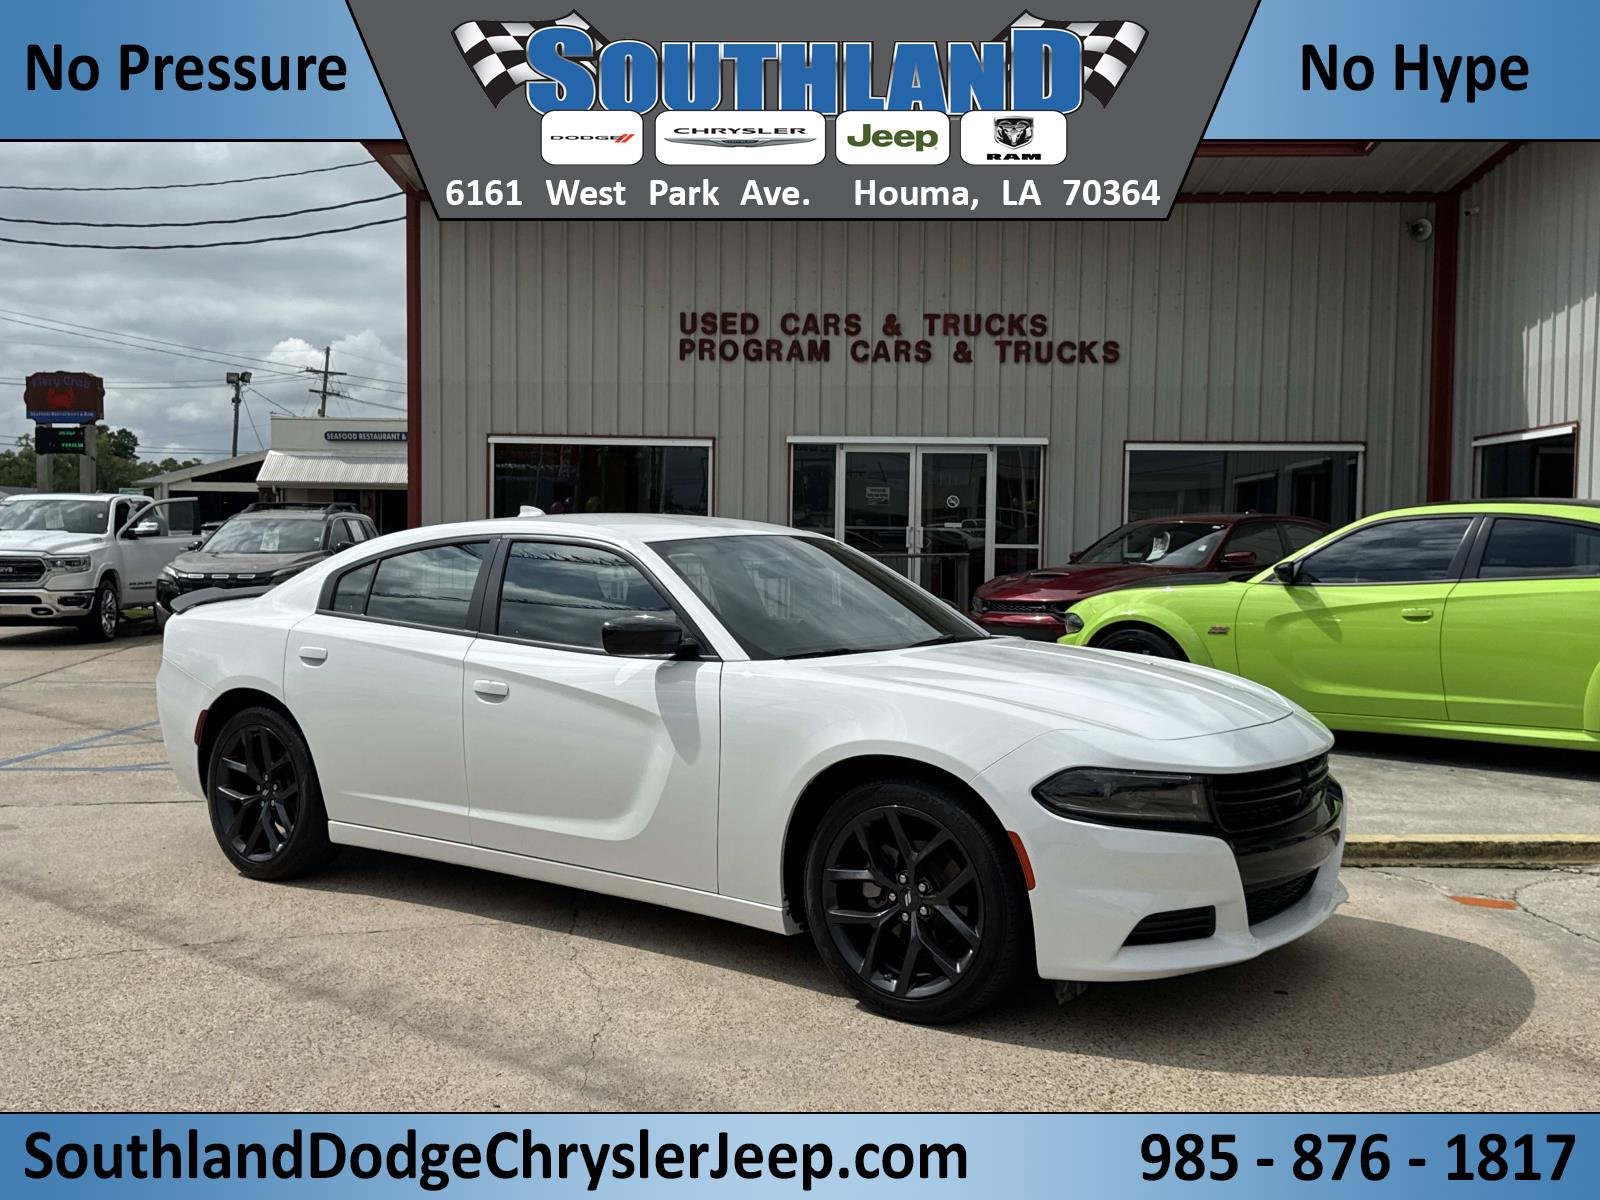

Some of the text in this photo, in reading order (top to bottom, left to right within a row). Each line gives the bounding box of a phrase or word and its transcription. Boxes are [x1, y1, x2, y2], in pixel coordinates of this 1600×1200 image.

[679, 312, 1047, 337] USED CARS & TRUCKS
[679, 338, 1120, 364] PROGRAM CARS & TRUCKS
[326, 432, 357, 440] SEAFOOD
[359, 432, 400, 440] RESTAURANT
